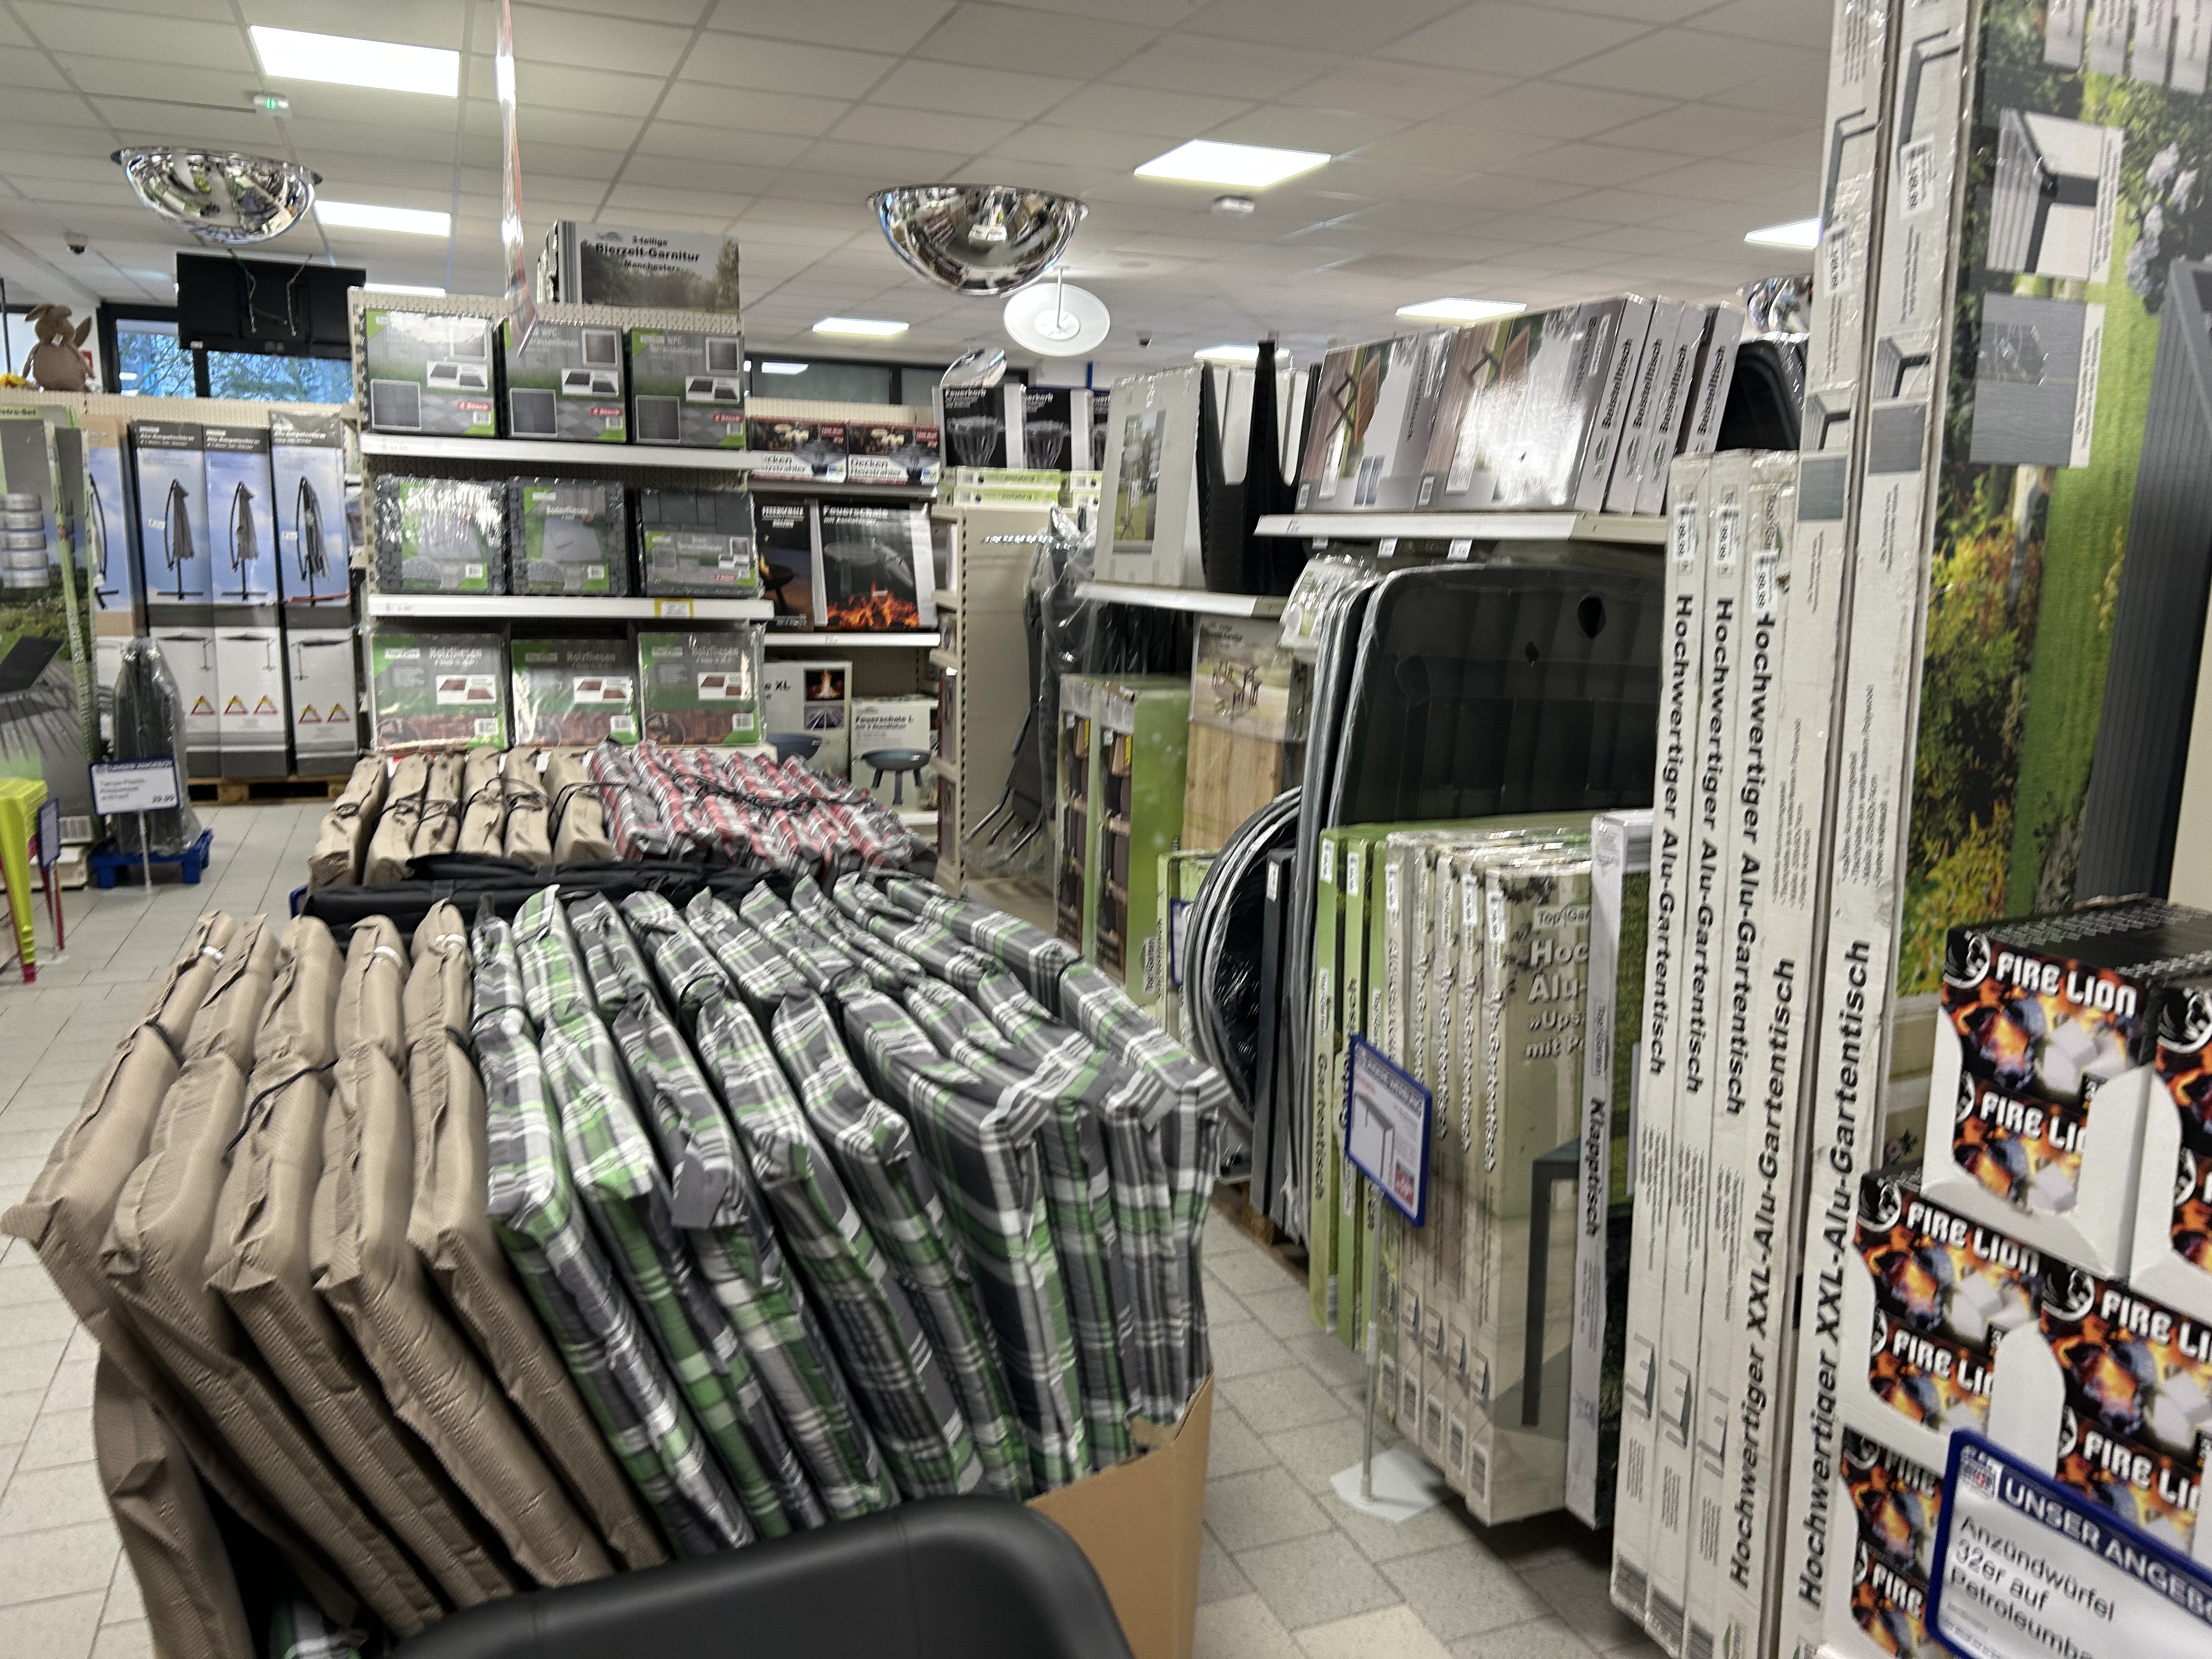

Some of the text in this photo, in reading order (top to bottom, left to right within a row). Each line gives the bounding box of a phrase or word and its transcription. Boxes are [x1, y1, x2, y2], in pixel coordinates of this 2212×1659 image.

[595, 242, 701, 263] Bierzelt-Garnitur
[1649, 594, 1694, 1076] Hochwertiger Alu-Gartentisch
[1686, 596, 1733, 1094] Hochwertiger Alu-Gartentisch
[1726, 853, 1760, 1116] Alu-Gartentisch
[1995, 951, 2137, 1019] FIRE LION
[1747, 957, 1796, 1340] XXL-Alu-Gartentisch
[1815, 938, 1871, 1344] XXL-Alu-Gartentisch
[1980, 1091, 2043, 1140] FIRE
[1585, 1097, 1606, 1238] Klapptisch
[1906, 1200, 2041, 1277] FIRE LION
[1892, 1328, 1952, 1380] FIRE
[2101, 1289, 2172, 1346] FIRE
[1729, 1345, 1767, 1590] Hochwertiger
[1798, 1348, 1838, 1610] Hochwertiger
[2084, 1430, 2153, 1490] FIRE
[2005, 1476, 2102, 1551] UNSER
[1956, 1538, 2051, 1613] 32er auf
[1960, 1515, 2115, 1623] Anzündwürfel
